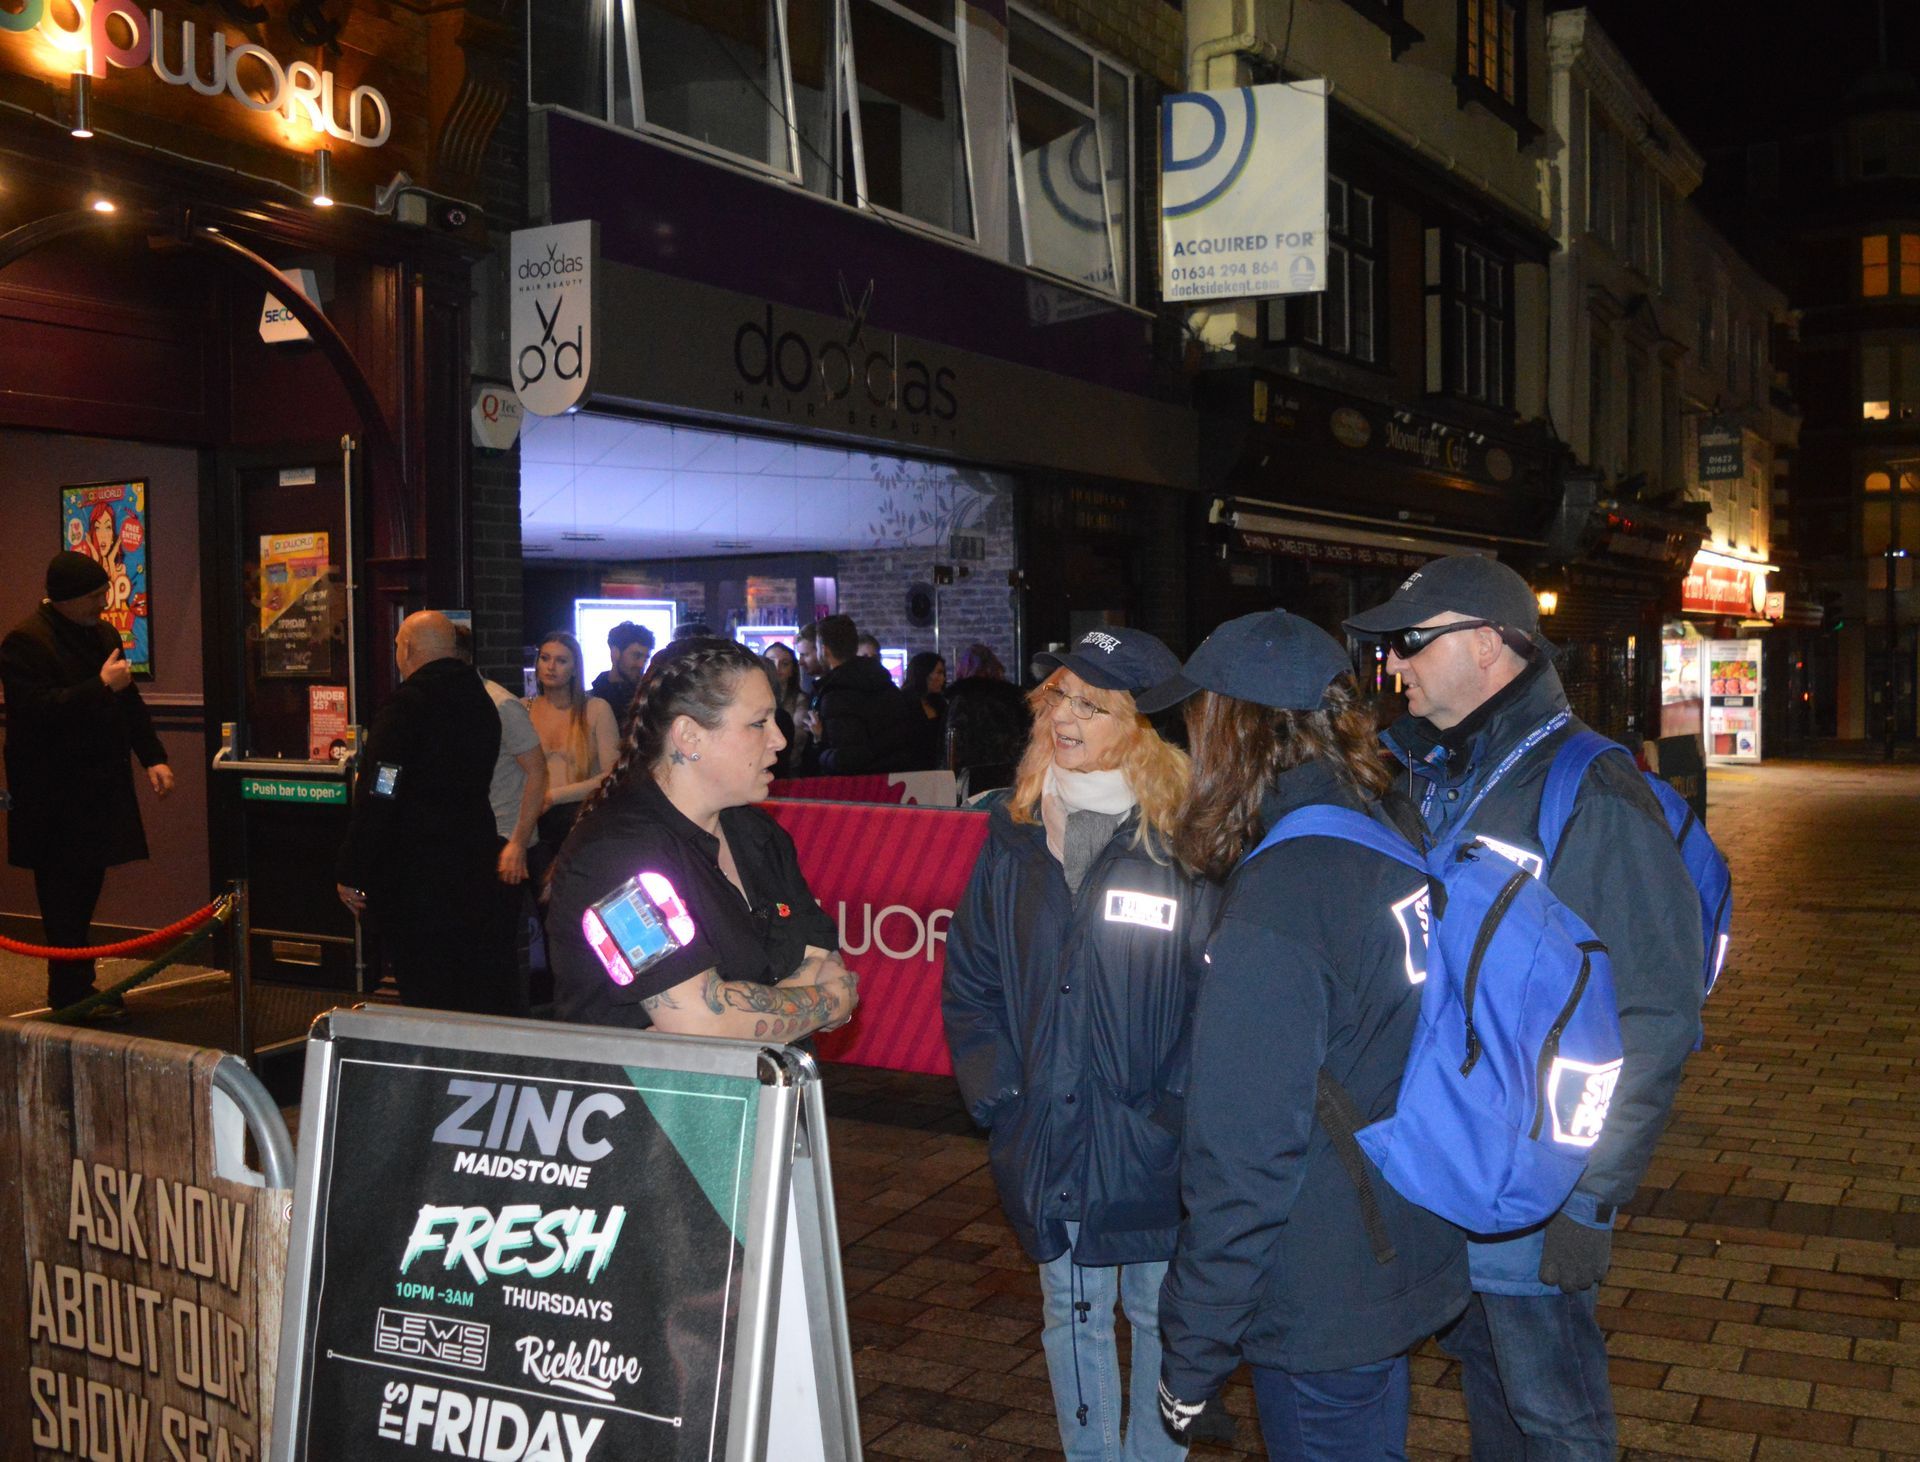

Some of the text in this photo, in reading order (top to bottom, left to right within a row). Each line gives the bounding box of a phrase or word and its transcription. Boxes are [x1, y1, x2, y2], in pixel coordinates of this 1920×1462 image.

[1173, 232, 1314, 257] ACQUIRED FOR
[518, 252, 584, 280] doodas
[1171, 261, 1279, 281] 01634 294 864
[519, 278, 584, 293] HAIR BEAUTY
[1171, 278, 1280, 297] docksidekent.com
[734, 302, 957, 420] doodas
[734, 390, 957, 437] HAIR BEAUTY
[1088, 631, 1122, 647] STREET
[312, 690, 345, 701] UNDER
[313, 700, 329, 710] 25?
[252, 782, 335, 800] Push bar to open
[432, 1078, 626, 1162] ZINC
[453, 1151, 592, 1189] MAIDSTONE
[68, 1158, 246, 1293] ASK NOW
[400, 1203, 627, 1286] FRESH
[395, 1282, 435, 1301] 10PM
[501, 1284, 614, 1322] THURSDAYS
[29, 1260, 249, 1415] ABOUT OUR
[379, 1311, 486, 1347] LEWIS
[378, 1332, 484, 1366] BONES
[30, 1366, 149, 1462] SHOW
[378, 1380, 606, 1462] IT'S FRIDAY
